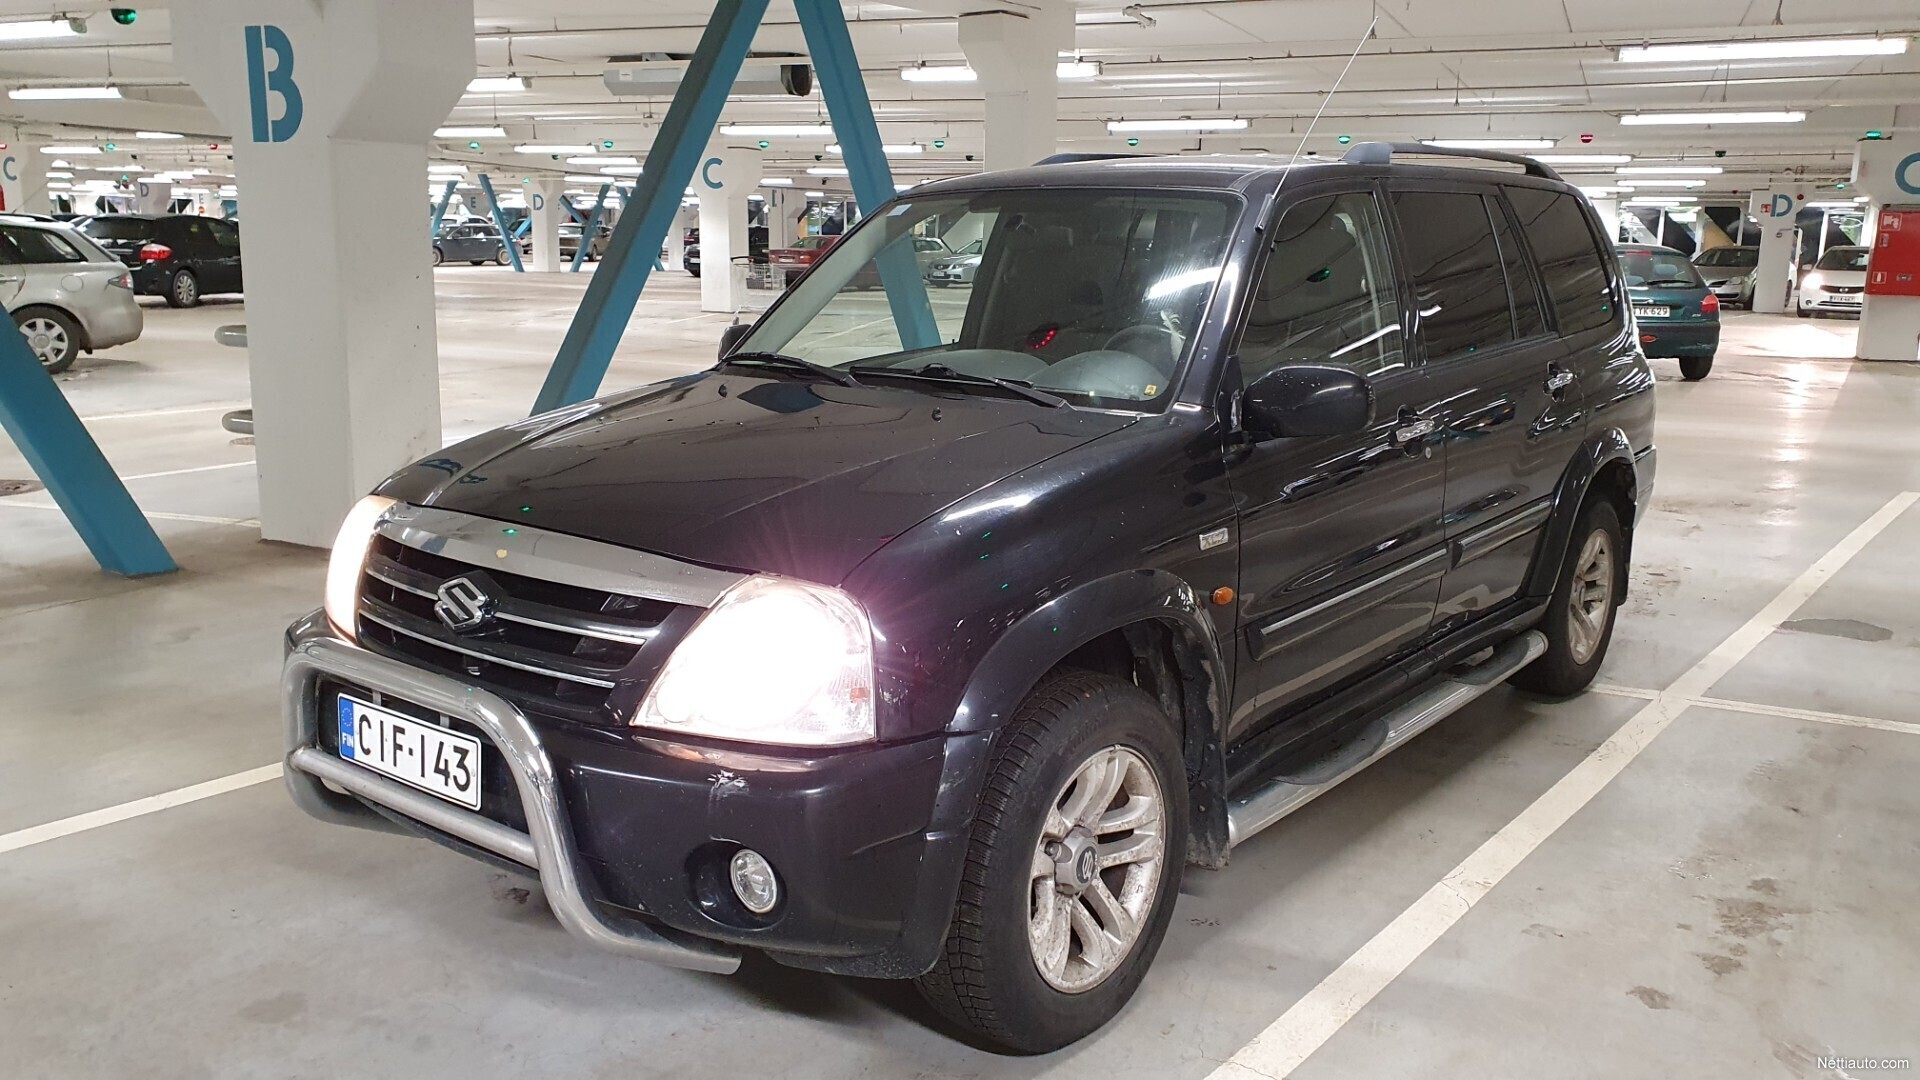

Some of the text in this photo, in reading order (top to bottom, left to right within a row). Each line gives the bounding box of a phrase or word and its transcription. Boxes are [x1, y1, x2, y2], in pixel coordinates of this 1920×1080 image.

[244, 25, 303, 143] B
[3, 156, 17, 181] C
[702, 157, 724, 189] C
[140, 182, 149, 197] D
[532, 193, 544, 210] D
[470, 196, 476, 209] E
[1770, 193, 1793, 217] D
[342, 732, 354, 749] FIN
[358, 713, 471, 792] CIF-143
